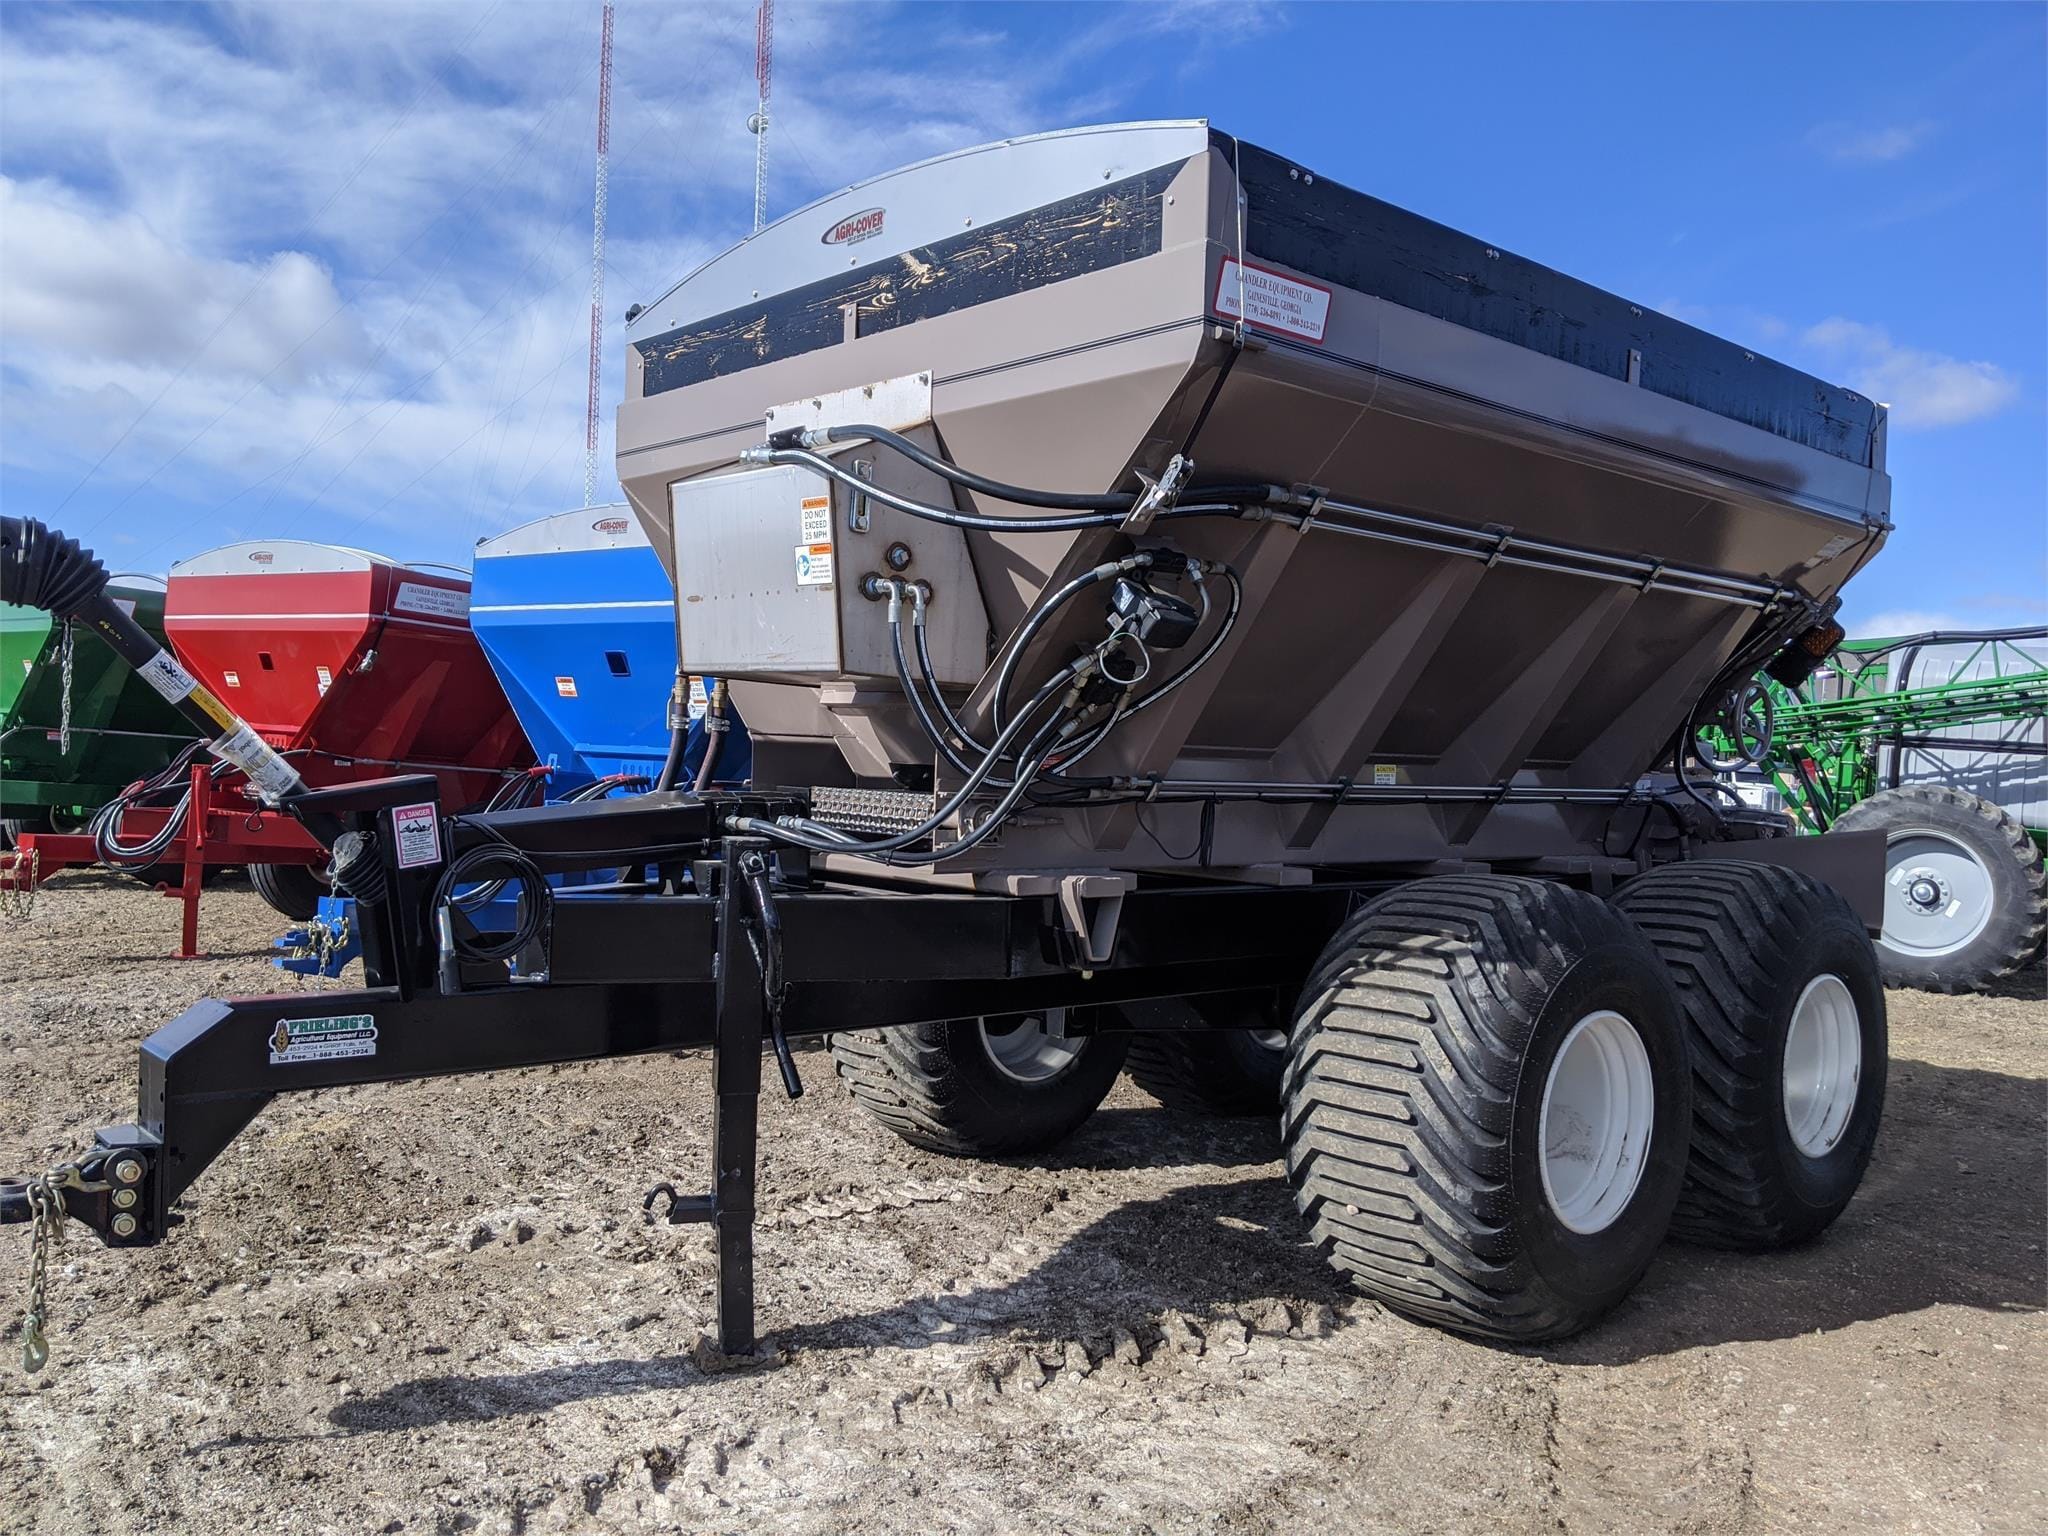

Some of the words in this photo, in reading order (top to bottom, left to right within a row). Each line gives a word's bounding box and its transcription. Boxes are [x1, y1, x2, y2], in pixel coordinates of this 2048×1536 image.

[834, 210, 884, 242] AGRI-COVER
[1268, 280, 1303, 301] EQUIPMENT
[1303, 292, 1314, 305] CO.
[1280, 301, 1302, 315] GEORGIA
[804, 511, 813, 519] DO
[814, 510, 826, 518] NOT
[805, 520, 827, 530] EXCEED
[805, 532, 812, 540] 25
[813, 530, 827, 539] MPH
[407, 808, 431, 818] DANGER
[288, 1015, 372, 1034] FRIELING'S
[290, 1035, 325, 1044] Agricultural
[327, 1031, 357, 1041] Equipment
